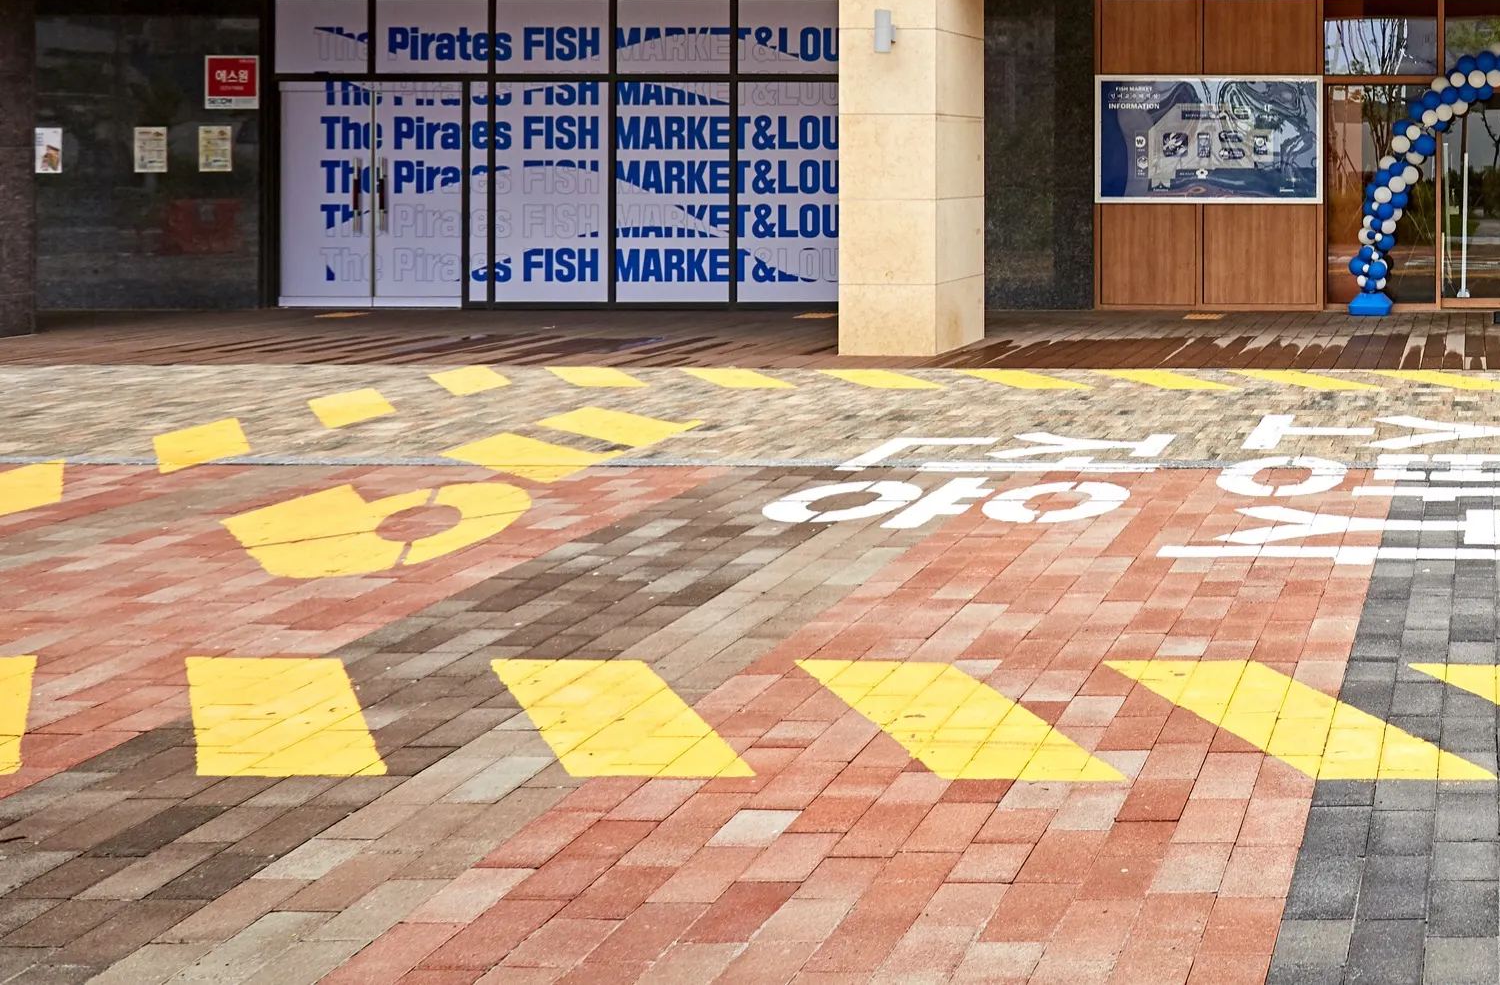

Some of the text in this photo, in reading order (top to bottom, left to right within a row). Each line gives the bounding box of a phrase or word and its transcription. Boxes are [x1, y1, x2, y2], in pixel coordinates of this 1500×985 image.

[523, 26, 600, 62] FISH
[215, 69, 249, 83] 에스원
[320, 115, 383, 150] The
[523, 115, 600, 150] FISH
[523, 247, 600, 282] FISH
[761, 431, 1177, 528] 전용
